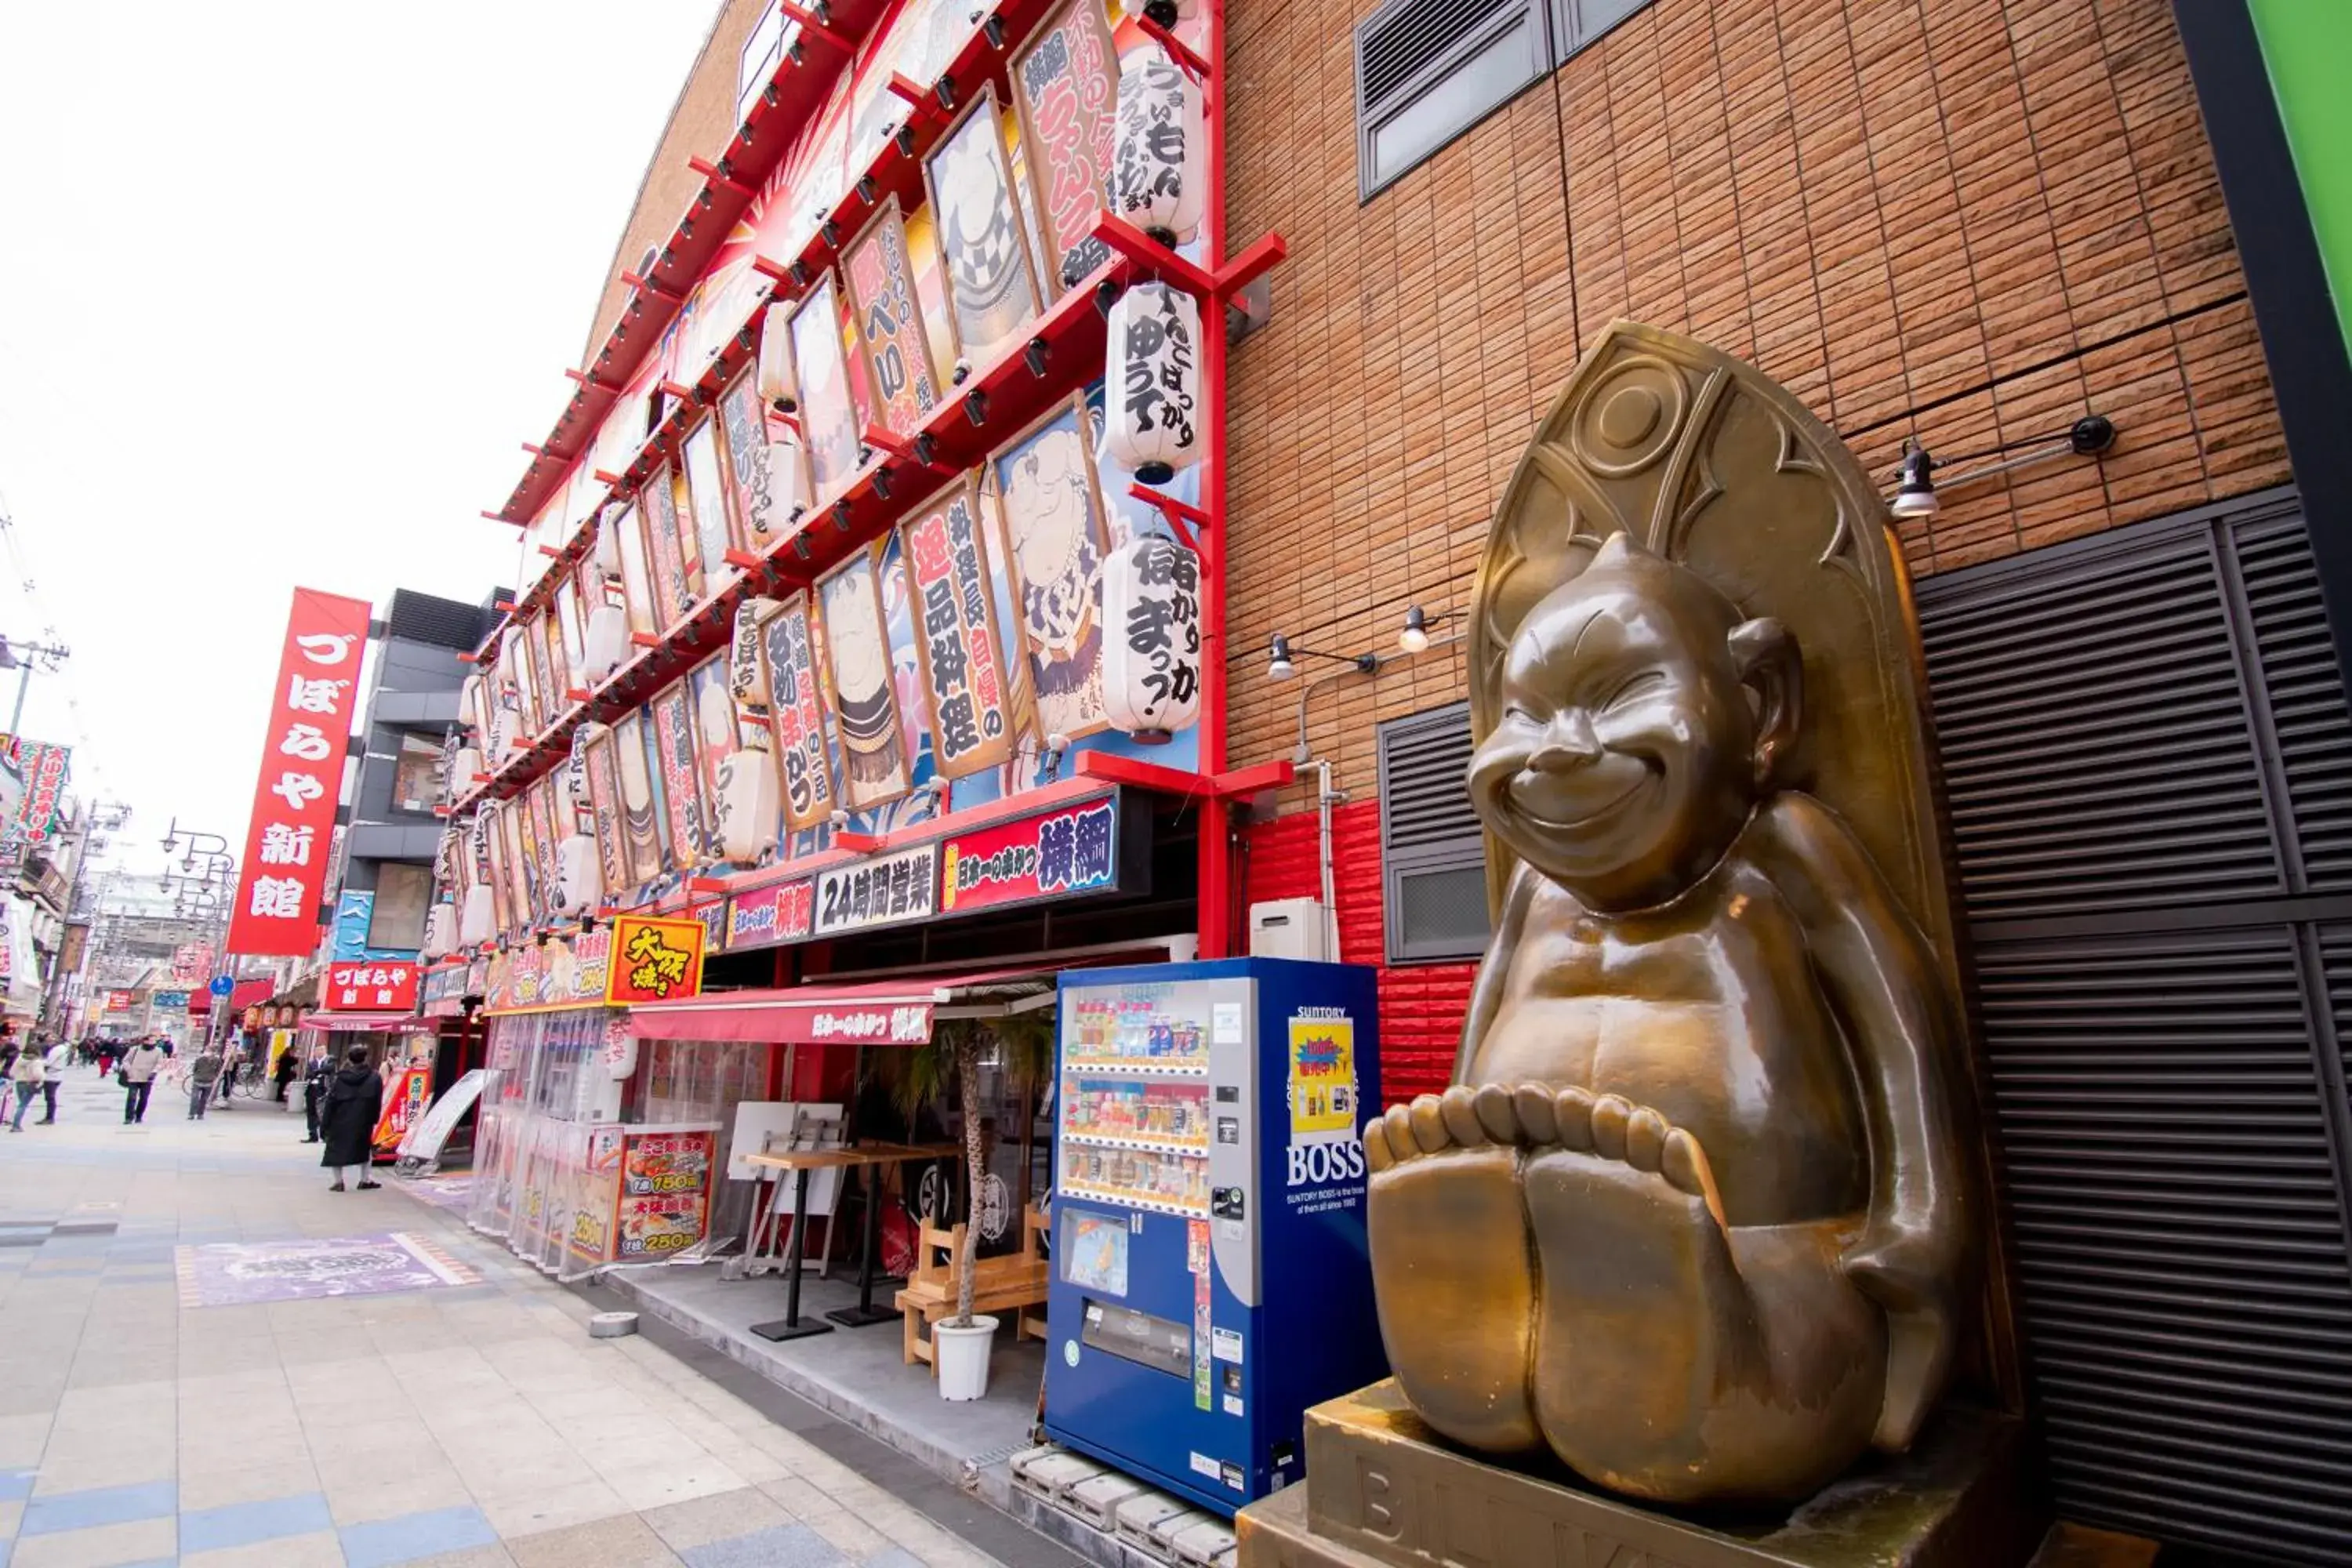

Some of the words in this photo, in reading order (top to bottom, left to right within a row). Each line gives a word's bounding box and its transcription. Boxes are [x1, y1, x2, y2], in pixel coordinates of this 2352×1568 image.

[249, 633, 357, 918] づぼらや新館
[956, 845, 1036, 889] 日本一の串かつ
[1037, 803, 1114, 891] 横綱
[822, 853, 933, 928] 24時間営業
[334, 968, 407, 986] づぼらや
[625, 926, 691, 996] 大阪焼き
[1298, 1006, 1345, 1018] SUNTORY
[1287, 1139, 1364, 1186] BOSS
